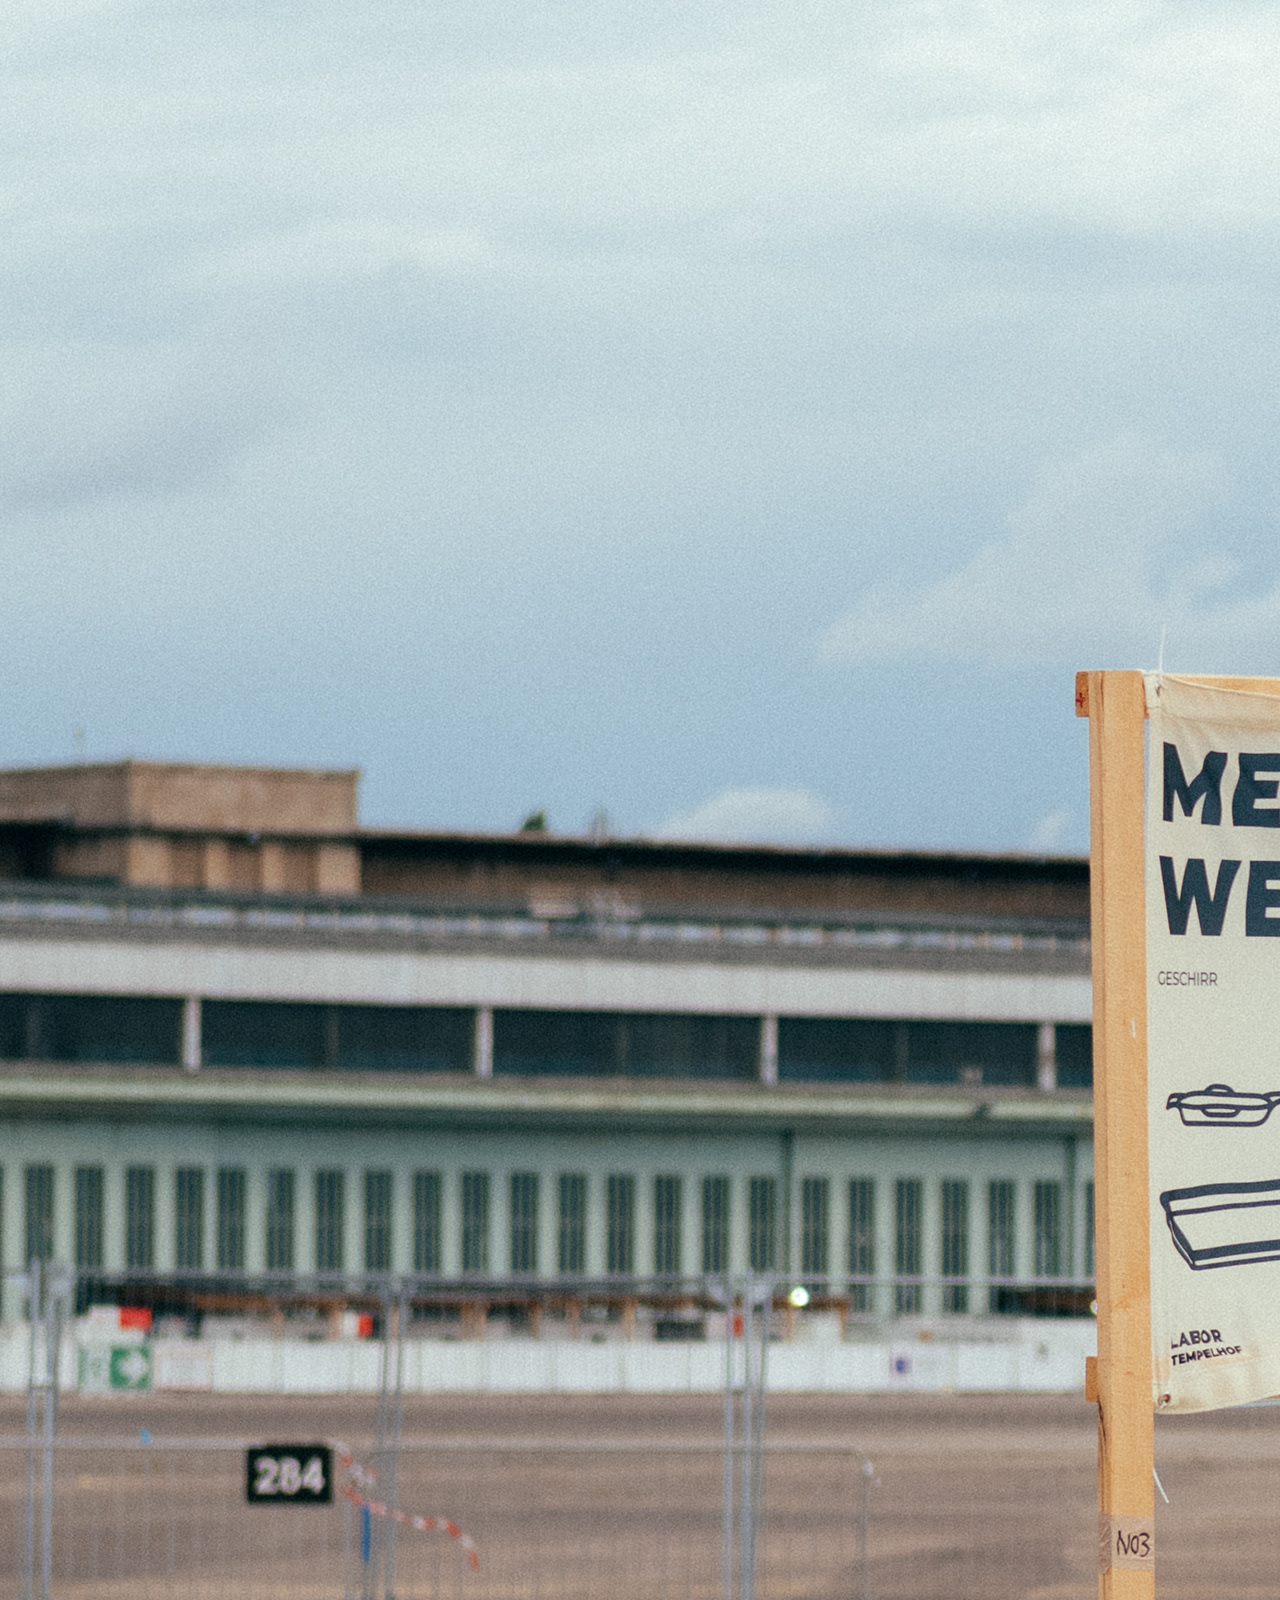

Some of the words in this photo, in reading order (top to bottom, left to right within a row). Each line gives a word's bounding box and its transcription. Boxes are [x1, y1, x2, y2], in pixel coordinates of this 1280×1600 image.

[1158, 971, 1218, 986] GESCHIRR
[1171, 1329, 1223, 1349] LABOR
[1171, 1345, 1243, 1366] TEMPELHOF
[255, 1455, 326, 1494] 284
